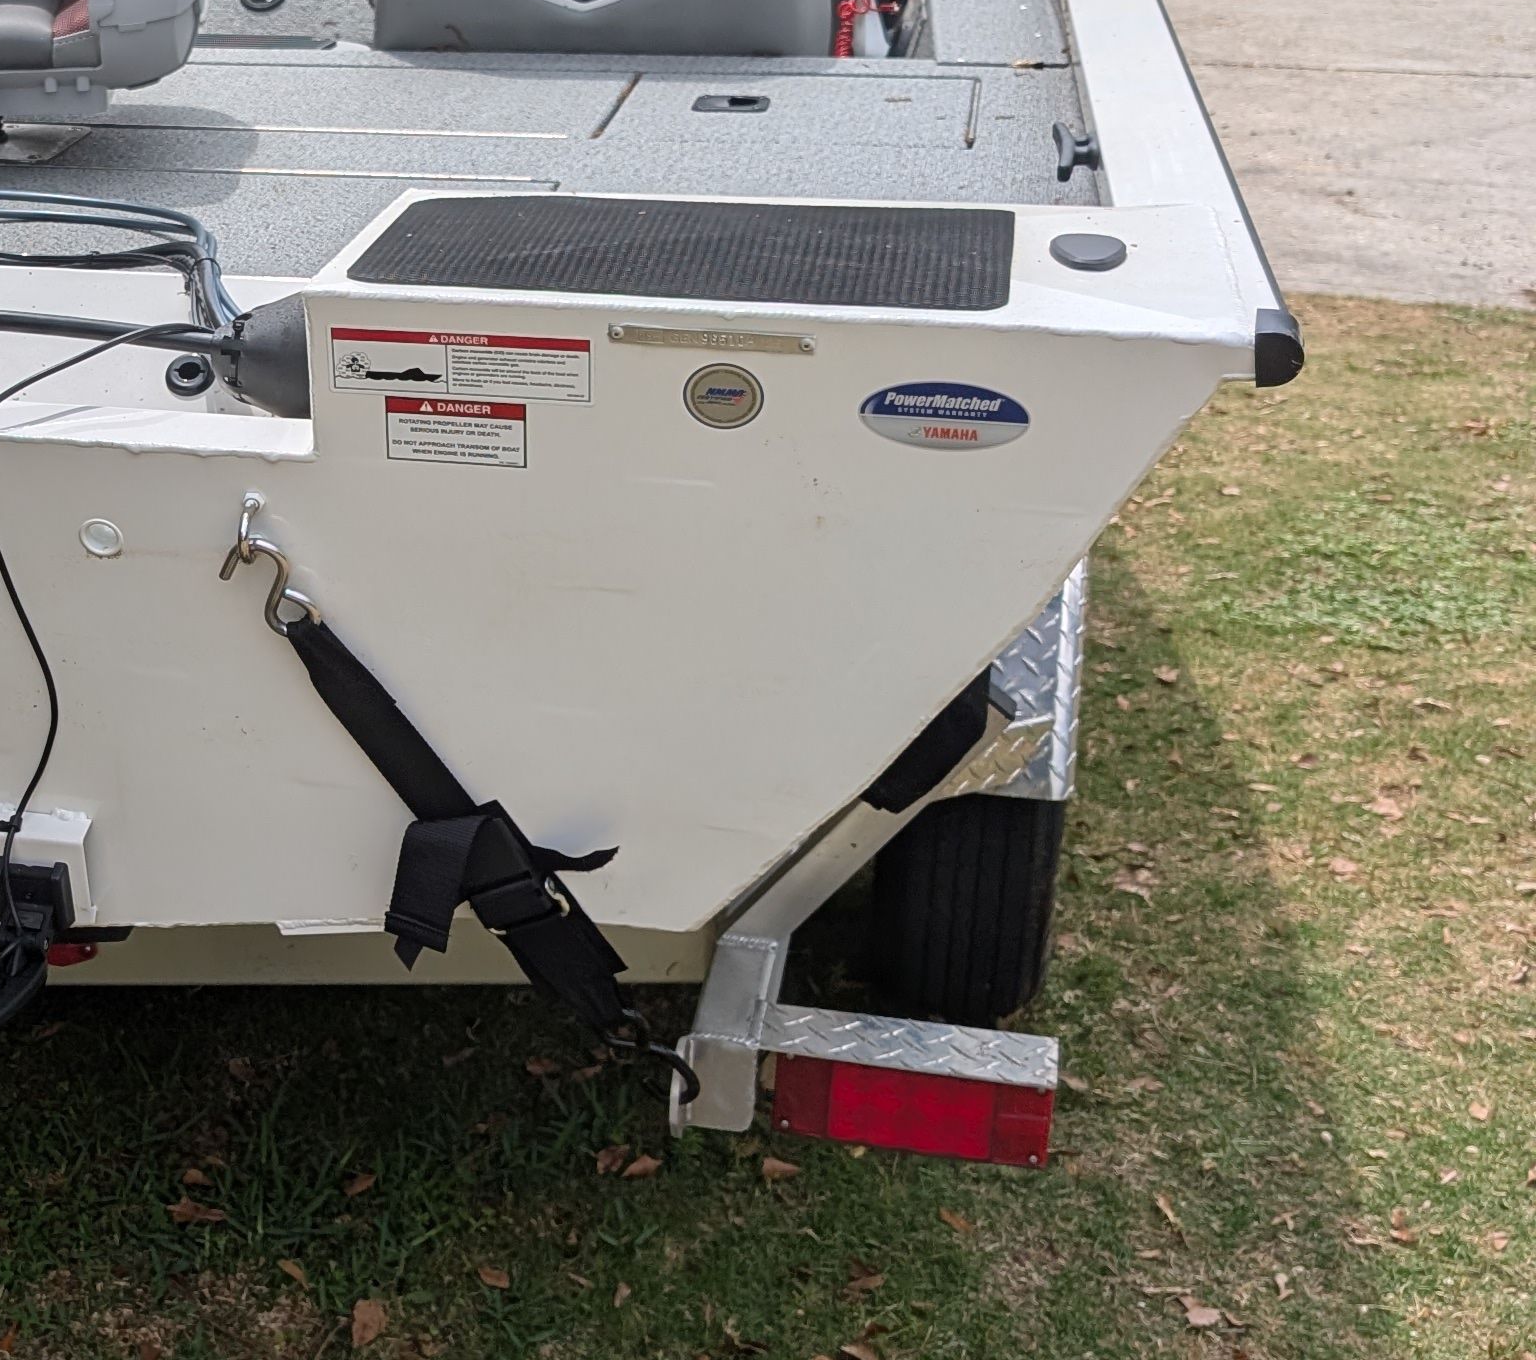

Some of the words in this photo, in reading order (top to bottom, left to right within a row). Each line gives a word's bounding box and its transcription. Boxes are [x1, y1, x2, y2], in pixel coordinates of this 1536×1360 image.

[441, 335, 489, 345] DANGER
[437, 402, 490, 415] DANGER
[884, 392, 1002, 412] PowerMatched
[923, 426, 978, 441] YAMAHA
